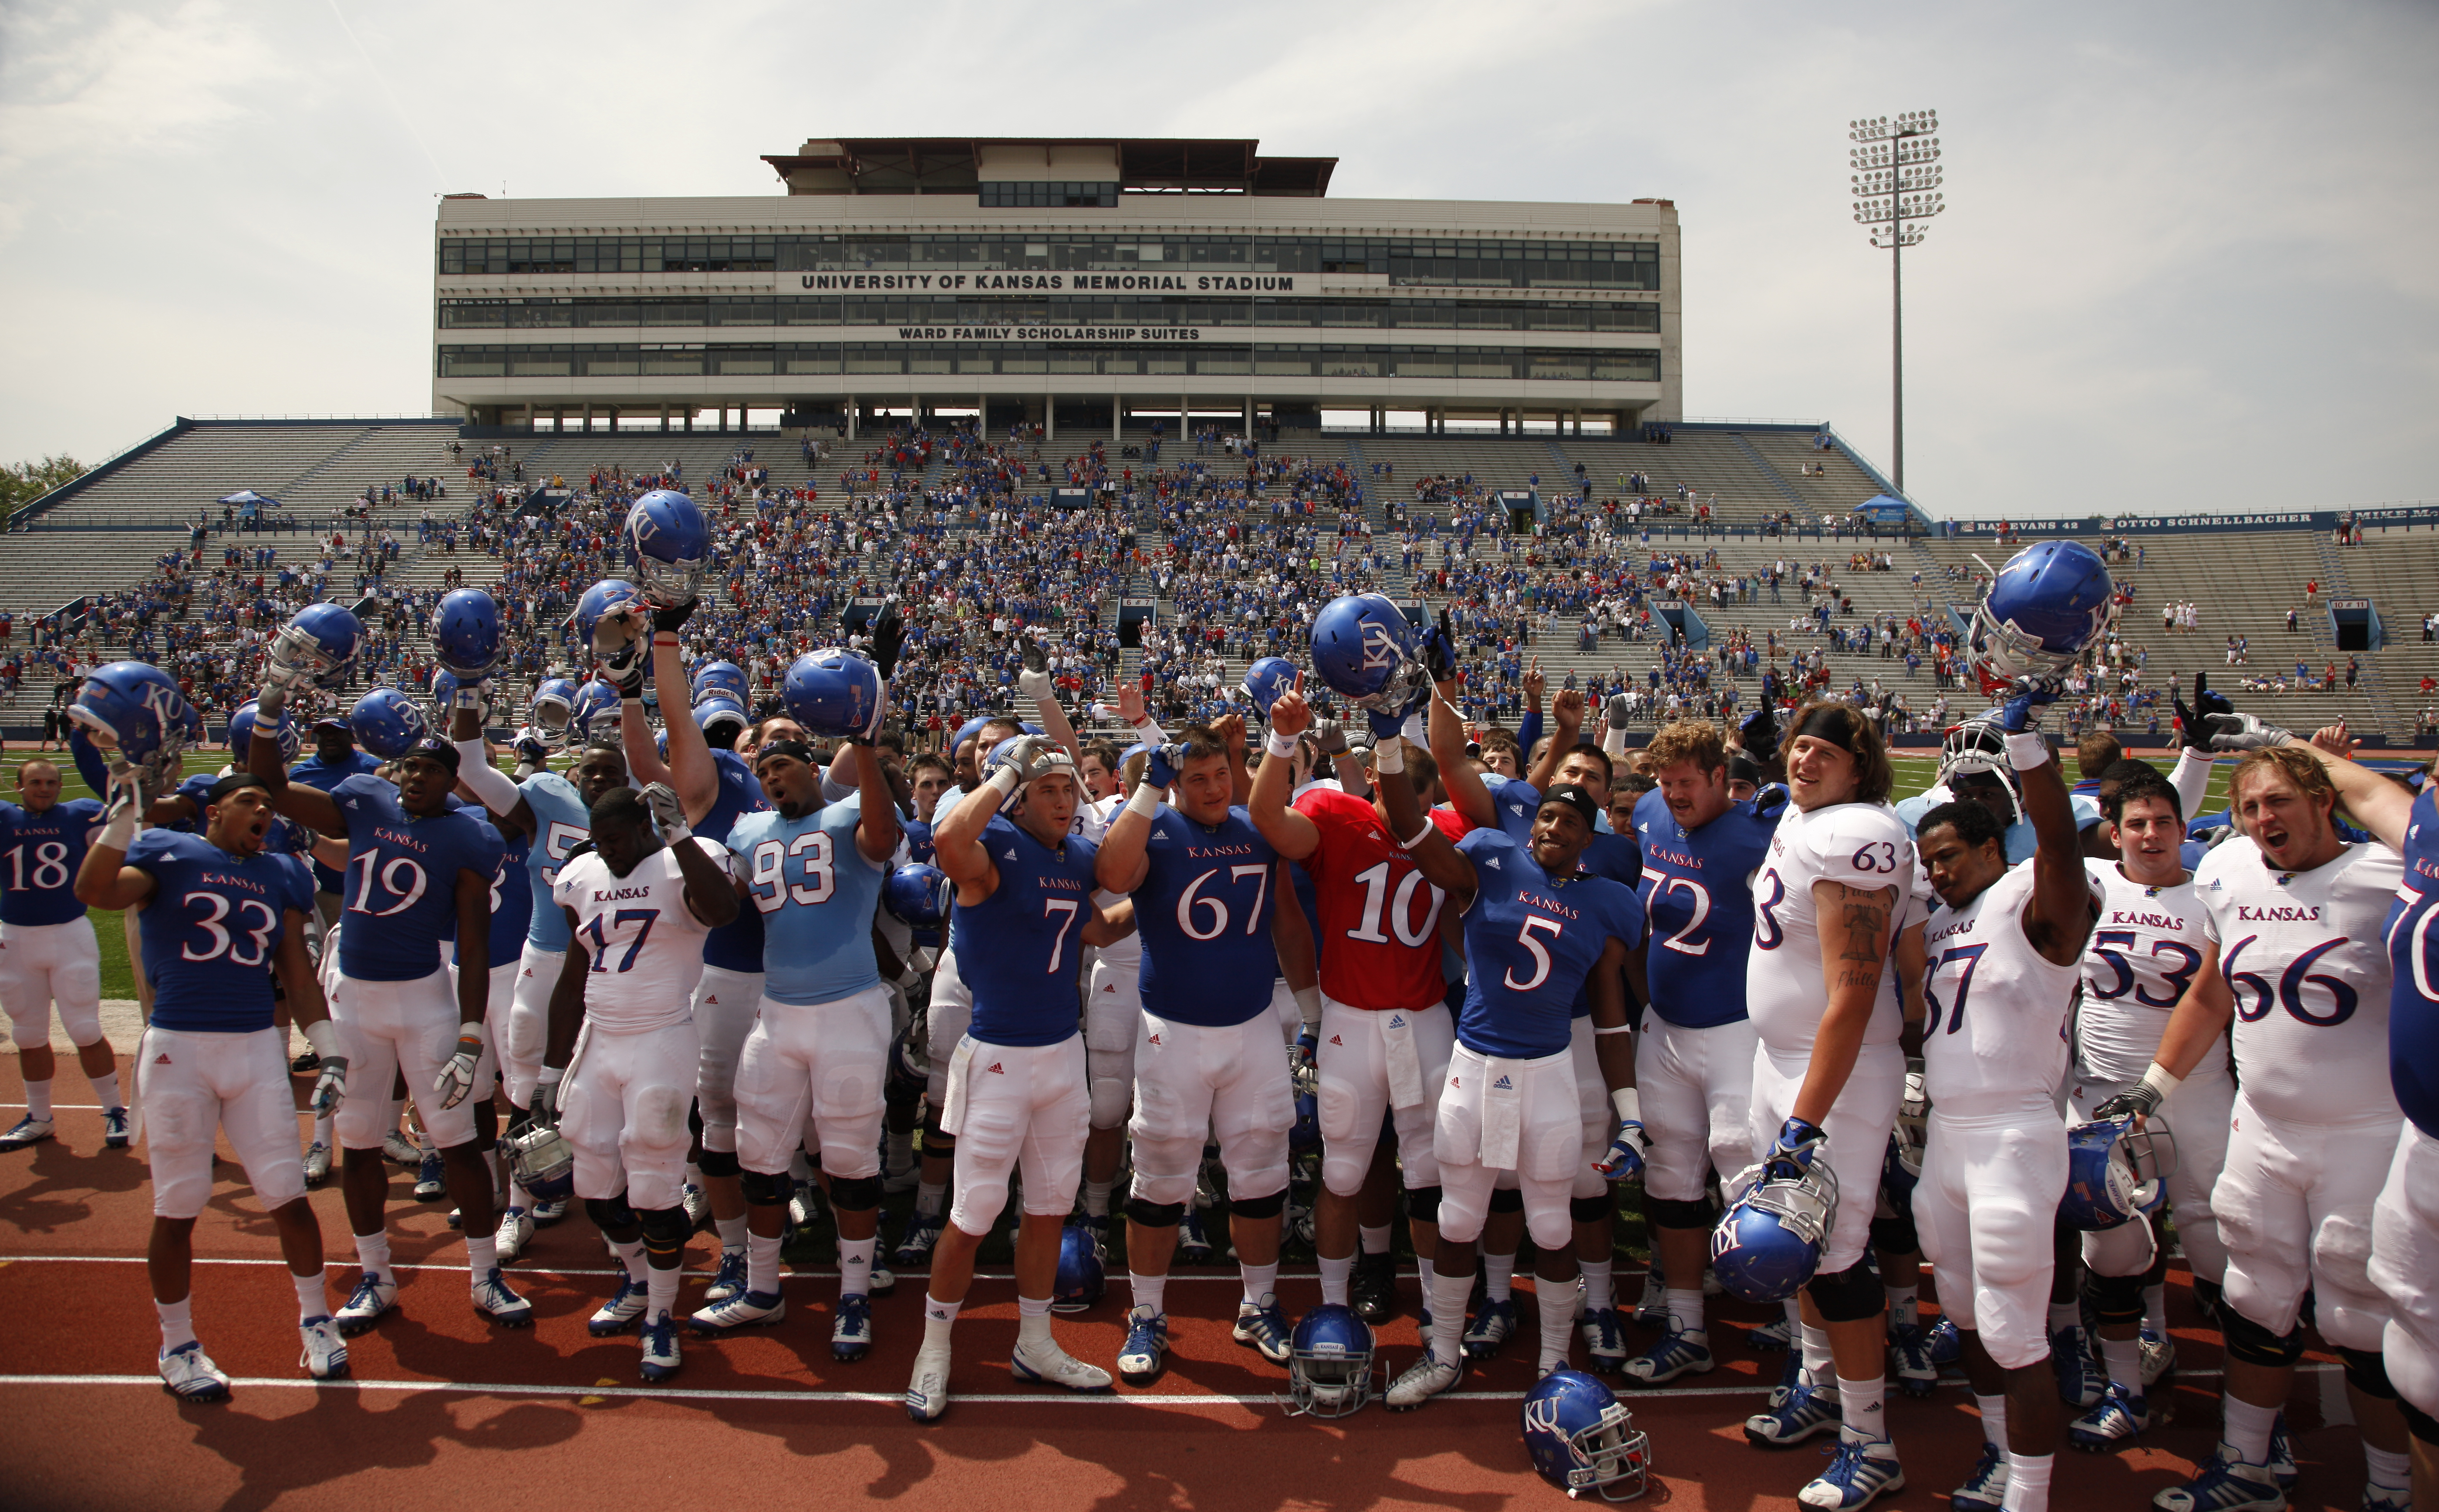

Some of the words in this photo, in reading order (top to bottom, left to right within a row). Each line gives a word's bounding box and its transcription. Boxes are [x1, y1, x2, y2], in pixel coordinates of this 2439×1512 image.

[802, 275, 932, 289] UNIVERSITY
[938, 275, 966, 289] OF
[975, 275, 1063, 289] KANSAS
[1073, 275, 1187, 290] MEMORIAL
[1198, 276, 1293, 290] STADIUM
[899, 328, 947, 339] WARD
[952, 328, 1011, 339] FAMILY
[1017, 328, 1136, 339] SCHOLARSHIP
[1141, 329, 1199, 340] SUITES
[630, 504, 661, 541] KU
[2010, 522, 2056, 530] EVANS
[2117, 519, 2160, 528] OTTO
[2167, 514, 2311, 526] SCHNELLBACHER
[2355, 511, 2408, 520] MIKE
[2088, 593, 2113, 637] K
[1359, 620, 1392, 671] KU
[2012, 627, 2033, 643] KANSAS
[141, 681, 185, 720] KU
[874, 691, 883, 722] JAYHAWKS
[389, 700, 423, 734] KU
[418, 738, 441, 749] KU
[1510, 805, 1522, 818] adidas
[14, 827, 61, 836] KANSAS
[1070, 815, 1085, 836] 3
[374, 827, 429, 853] KANSAS
[1188, 844, 1252, 858] KANSAS
[1771, 832, 1785, 858] ANSAS
[2, 842, 69, 891] 18
[1388, 850, 1412, 861] KANS
[1485, 861, 1501, 870] adidas
[1650, 843, 1704, 869] KANSAS
[1851, 841, 1897, 874] 63
[201, 871, 266, 894] KANSAS
[348, 846, 428, 916] 19
[749, 829, 836, 915] 93
[1039, 876, 1081, 891] KANSAS
[594, 886, 650, 902] KANSAS
[1176, 863, 1268, 940] 67
[1346, 860, 1447, 948] 10
[1518, 890, 1579, 920] KANSAS
[1641, 865, 1710, 956] 72
[1754, 867, 1786, 950] 3
[2112, 911, 2184, 930] KANSAS
[2238, 906, 2320, 921] KANSAS
[181, 891, 277, 966] 33
[579, 909, 661, 973] 17
[1045, 898, 1079, 975] 7
[1931, 919, 1976, 944] KANSAS
[1503, 913, 1564, 992] 5
[1835, 970, 1878, 991] Philly
[2088, 931, 2203, 1008] 53
[2222, 934, 2358, 1027] 66
[1450, 1080, 1460, 1089] adidas
[2072, 1091, 2083, 1099] adidas
[2107, 1179, 2125, 1211] JAYHAWKS
[1709, 1219, 1742, 1261] KU
[1786, 1223, 1806, 1239] KANSAS
[930, 1310, 947, 1320] adidas
[1524, 1396, 1562, 1434] KU
[1566, 1439, 1585, 1458] Rddell
